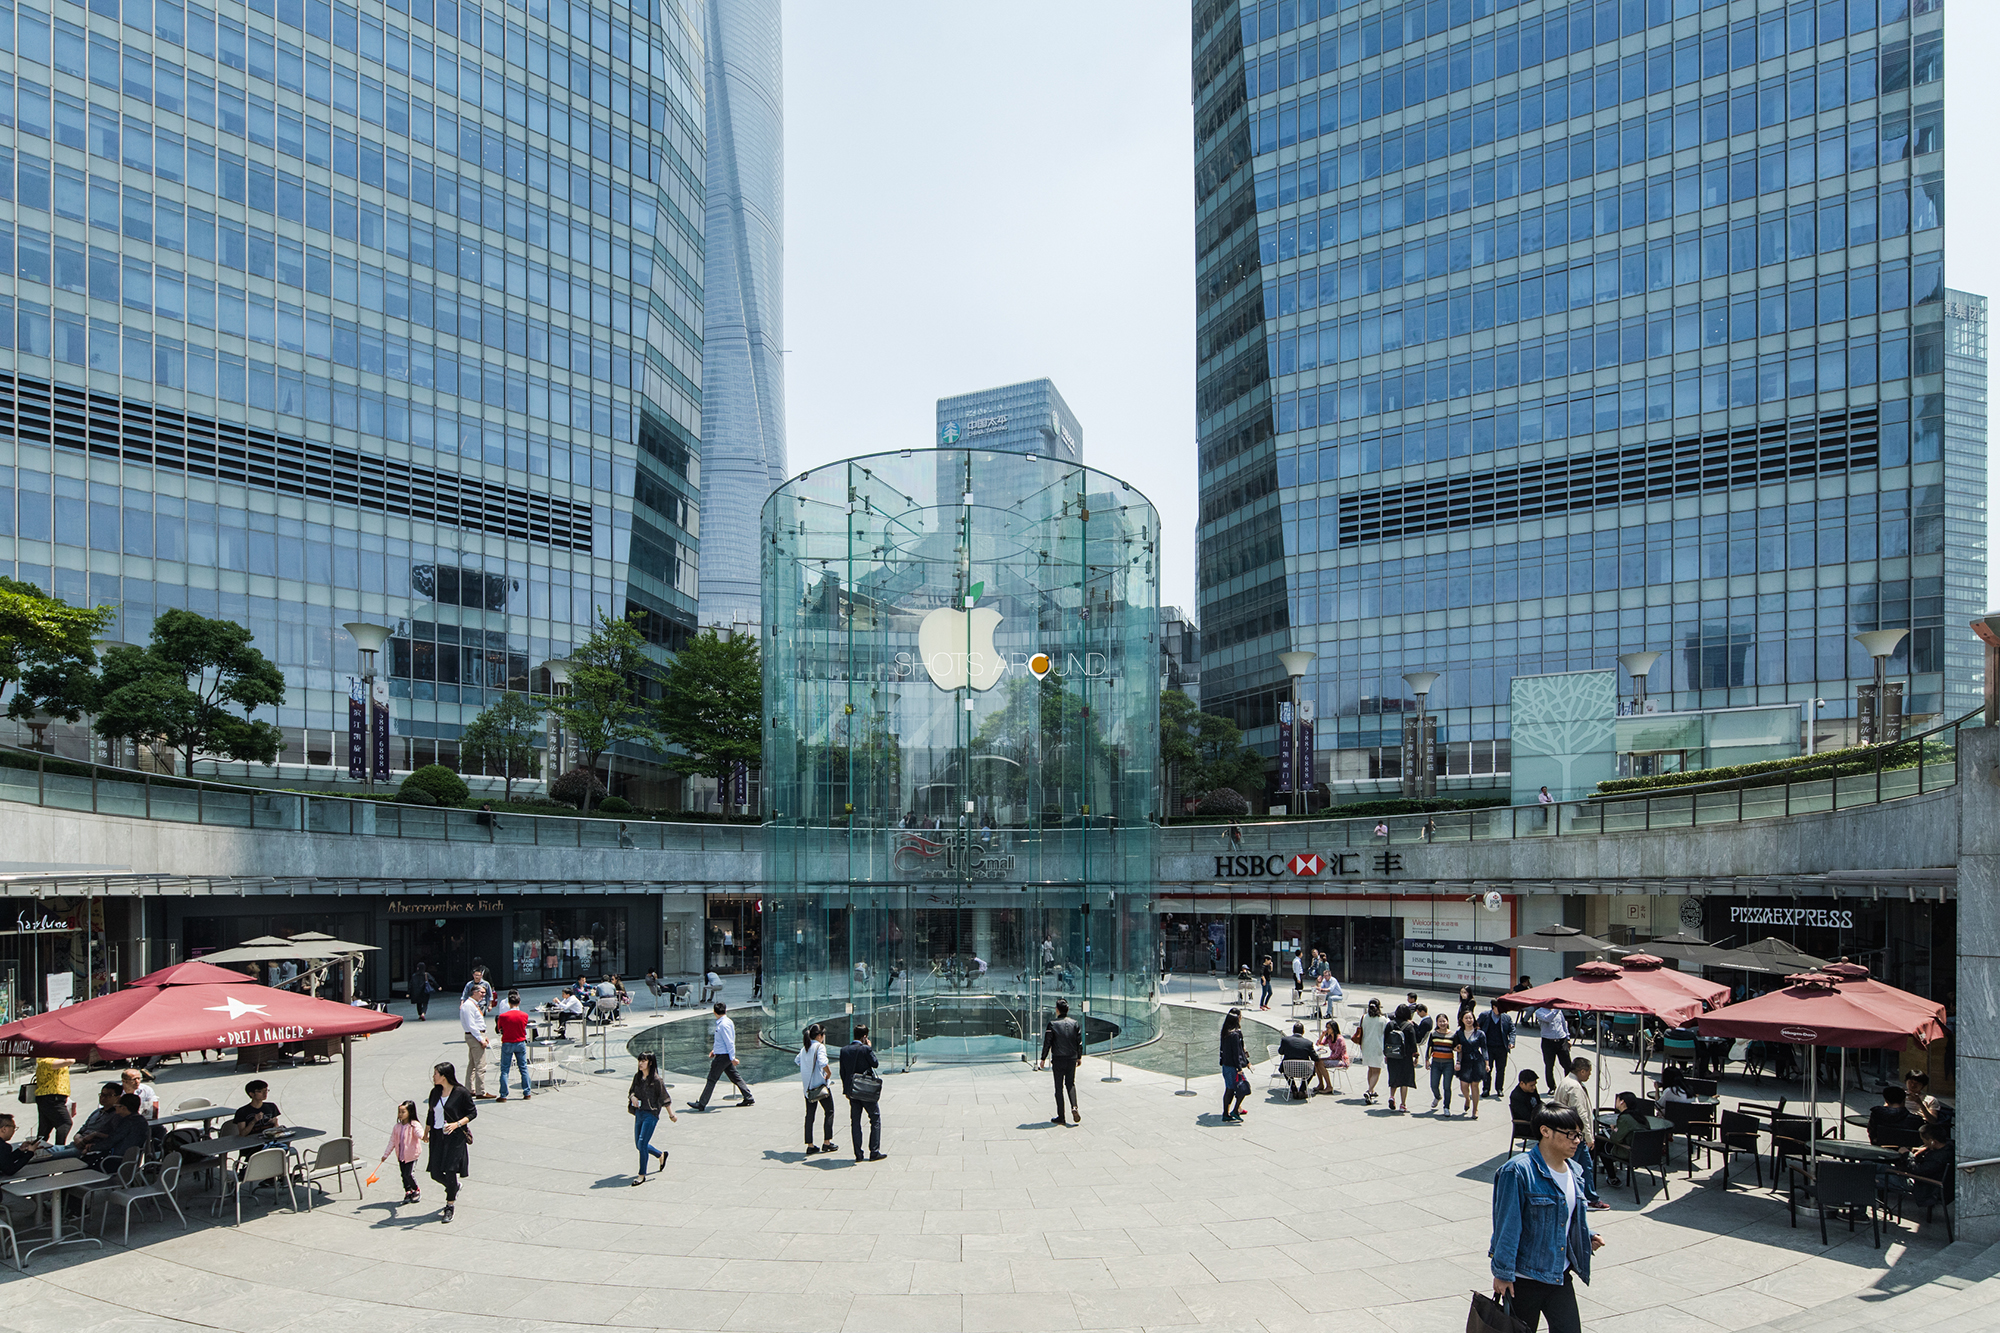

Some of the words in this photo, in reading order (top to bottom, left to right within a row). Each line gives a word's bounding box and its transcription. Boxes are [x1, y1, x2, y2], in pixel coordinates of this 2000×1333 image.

[967, 414, 1008, 431] 中国太平
[1886, 728, 1898, 738] ifc
[985, 854, 1015, 870] mall
[1214, 854, 1285, 877] HSBC
[1329, 851, 1403, 876] 汇丰
[387, 900, 463, 914] Abercrombie
[466, 902, 475, 912] &
[478, 899, 504, 911] Fitch
[1412, 919, 1440, 927] Welcome
[1730, 906, 1854, 929] PIZZAEXPRESS
[1427, 957, 1447, 965] Business
[227, 1030, 251, 1045] PRET
[254, 1029, 261, 1043] A
[263, 1025, 304, 1041] MANGER
